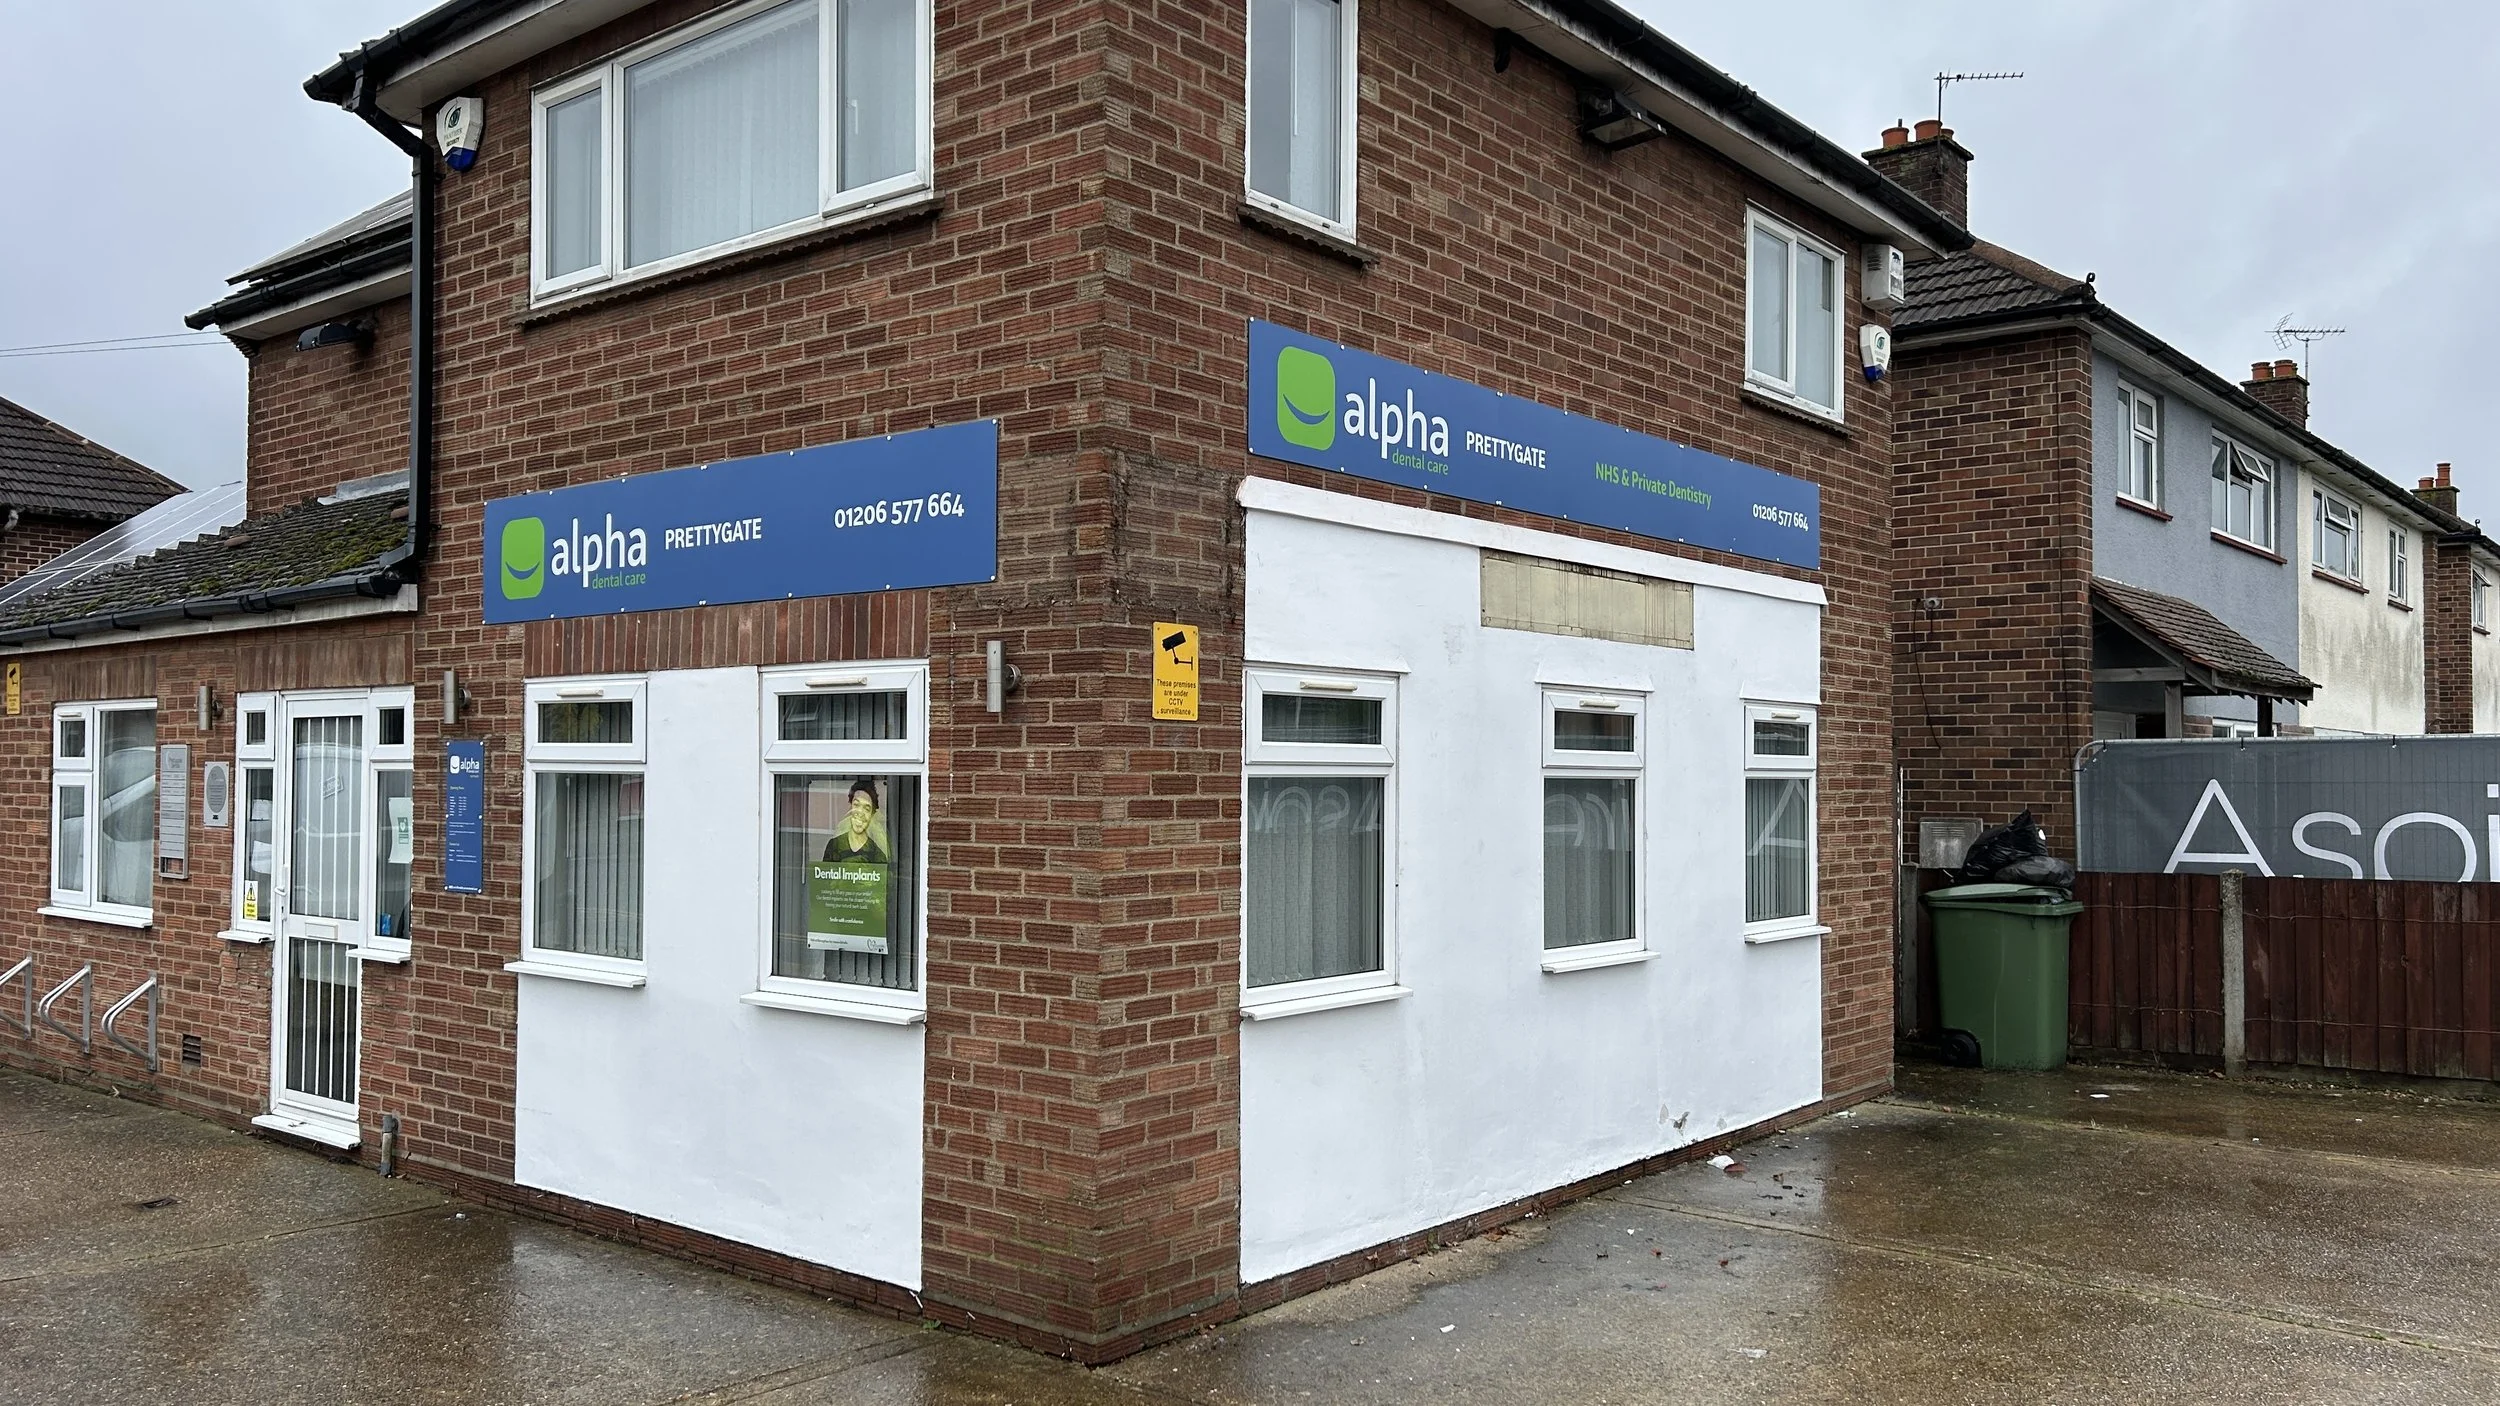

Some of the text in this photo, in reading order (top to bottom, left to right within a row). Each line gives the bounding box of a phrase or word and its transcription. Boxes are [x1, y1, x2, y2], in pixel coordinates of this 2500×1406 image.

[1343, 378, 1449, 460] alpha
[1392, 447, 1449, 476] dental care
[1466, 430, 1546, 469] PRETTYGATE
[1595, 461, 1713, 510] NHS & Private Dentistry
[834, 492, 965, 529] 01206 577 664
[1752, 503, 1809, 532] 01206 577 664
[665, 518, 762, 550] PRETTYGATE
[551, 513, 648, 588] alpha
[592, 571, 647, 590] dental care
[1156, 679, 1196, 688] These premises
[460, 757, 480, 773] alpha
[814, 866, 881, 884] Dental Implants
